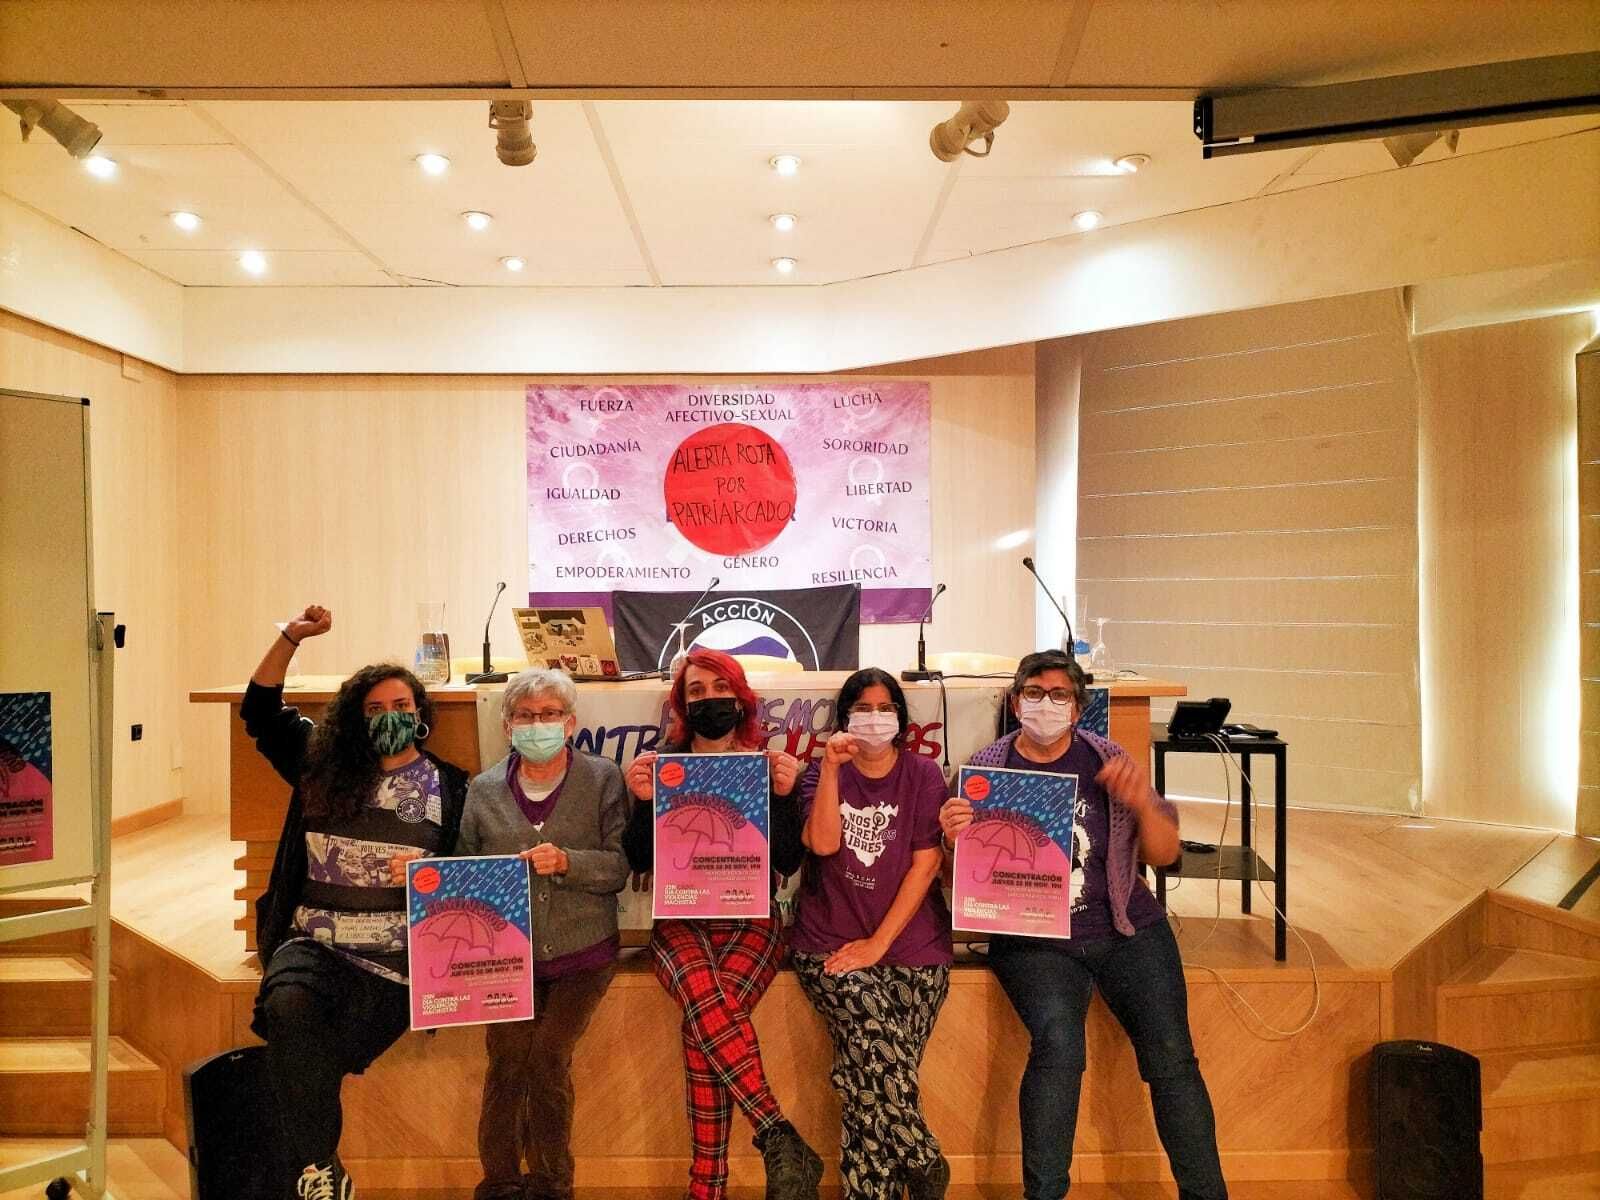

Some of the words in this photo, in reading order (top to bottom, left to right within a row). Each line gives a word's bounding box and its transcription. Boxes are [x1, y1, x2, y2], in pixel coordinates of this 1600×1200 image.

[580, 399, 634, 412] FUERZA
[688, 393, 775, 406] DIVERSIDAD
[833, 392, 882, 409] LUCHA
[665, 409, 794, 422] AFECTIVO-SEXUAL
[550, 438, 642, 458] CIUDADANÍA
[822, 438, 909, 456] SORORIDAD
[672, 443, 732, 474] ALERTA
[736, 442, 776, 465] ROJA
[546, 487, 621, 500] IGUALDAD
[714, 476, 747, 495] POR
[846, 481, 912, 496] LIBERTAD
[672, 499, 792, 527] PATRIARCADO
[831, 516, 898, 534] VICTORIA
[558, 527, 637, 545] DERECHOS
[723, 554, 779, 569] GÉNERO
[556, 566, 691, 579] EMPODERAMIENTO
[811, 566, 898, 585] RESILIENCIA
[701, 602, 777, 629] ACCIÓN
[849, 812, 871, 828] NOS
[842, 819, 897, 841] UEREMOS
[847, 835, 881, 853] IBRES
[693, 854, 760, 863] CONCENTRACIÓN
[993, 871, 1062, 882] CONCENTRACIÓN
[451, 955, 524, 970] CONCENTRACIÓN
